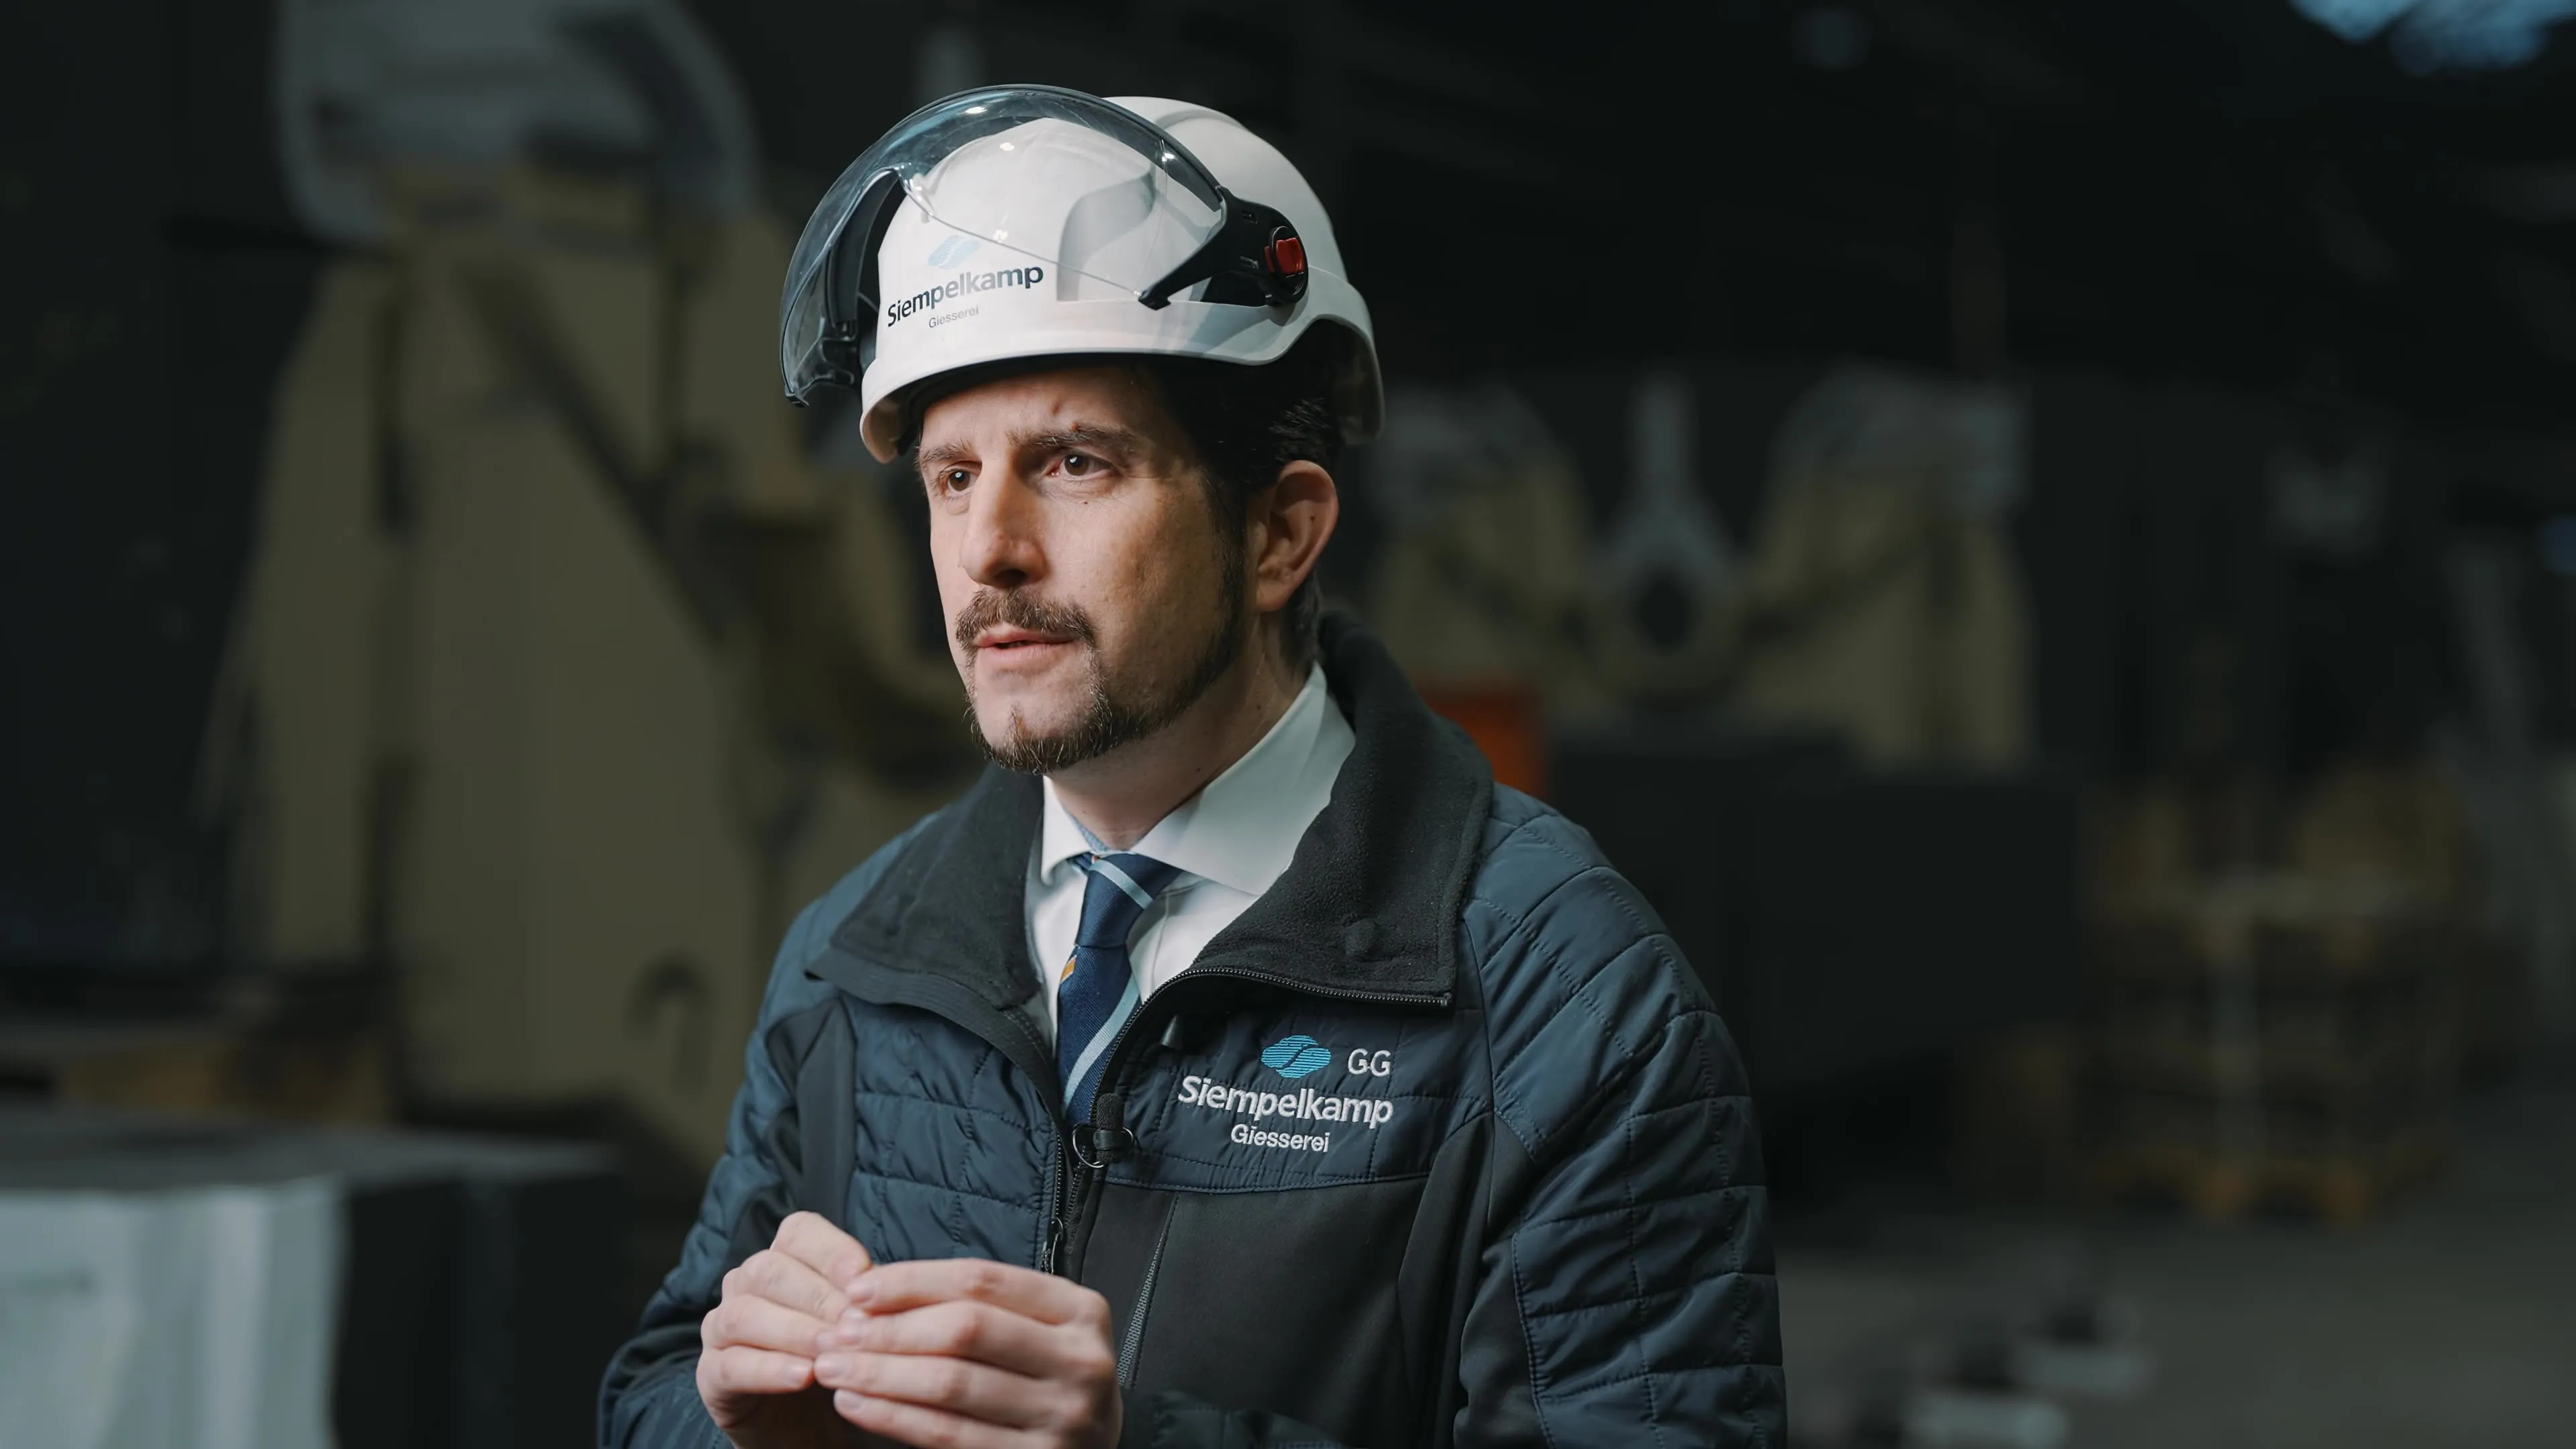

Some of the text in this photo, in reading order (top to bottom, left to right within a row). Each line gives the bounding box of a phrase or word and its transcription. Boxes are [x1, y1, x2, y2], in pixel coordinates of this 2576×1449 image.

[888, 266, 1044, 327] Siempelkamp
[928, 305, 979, 328] Giesserei
[1348, 1048, 1391, 1077] GG
[1178, 1075, 1394, 1129] Siempelkamp
[1230, 1124, 1330, 1152] Giesserei
